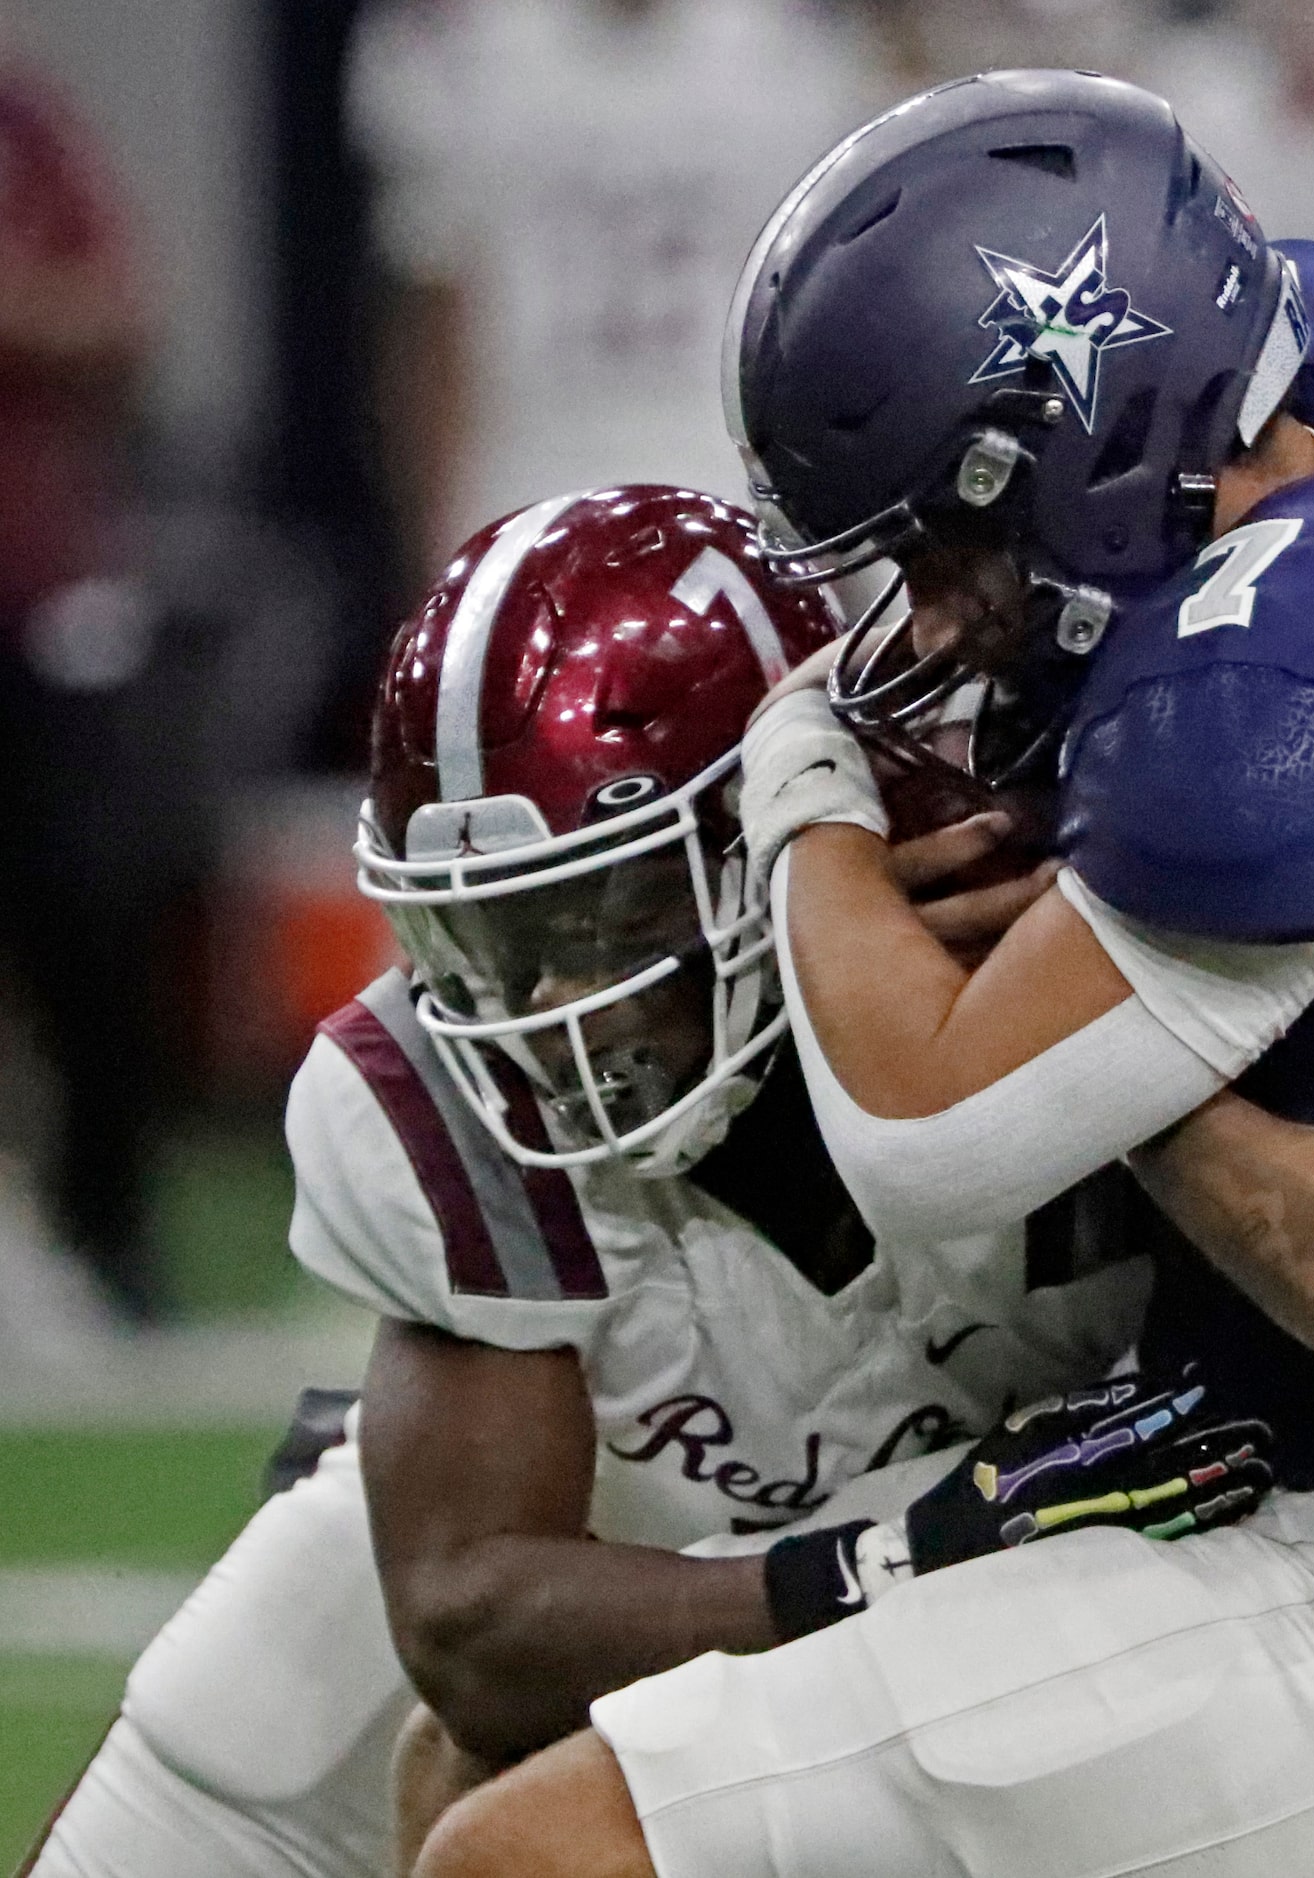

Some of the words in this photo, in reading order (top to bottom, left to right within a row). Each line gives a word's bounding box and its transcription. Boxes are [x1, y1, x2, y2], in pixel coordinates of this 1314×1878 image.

[669, 544, 791, 692] 7
[1177, 518, 1304, 639] 7
[606, 1394, 834, 1508] Red
